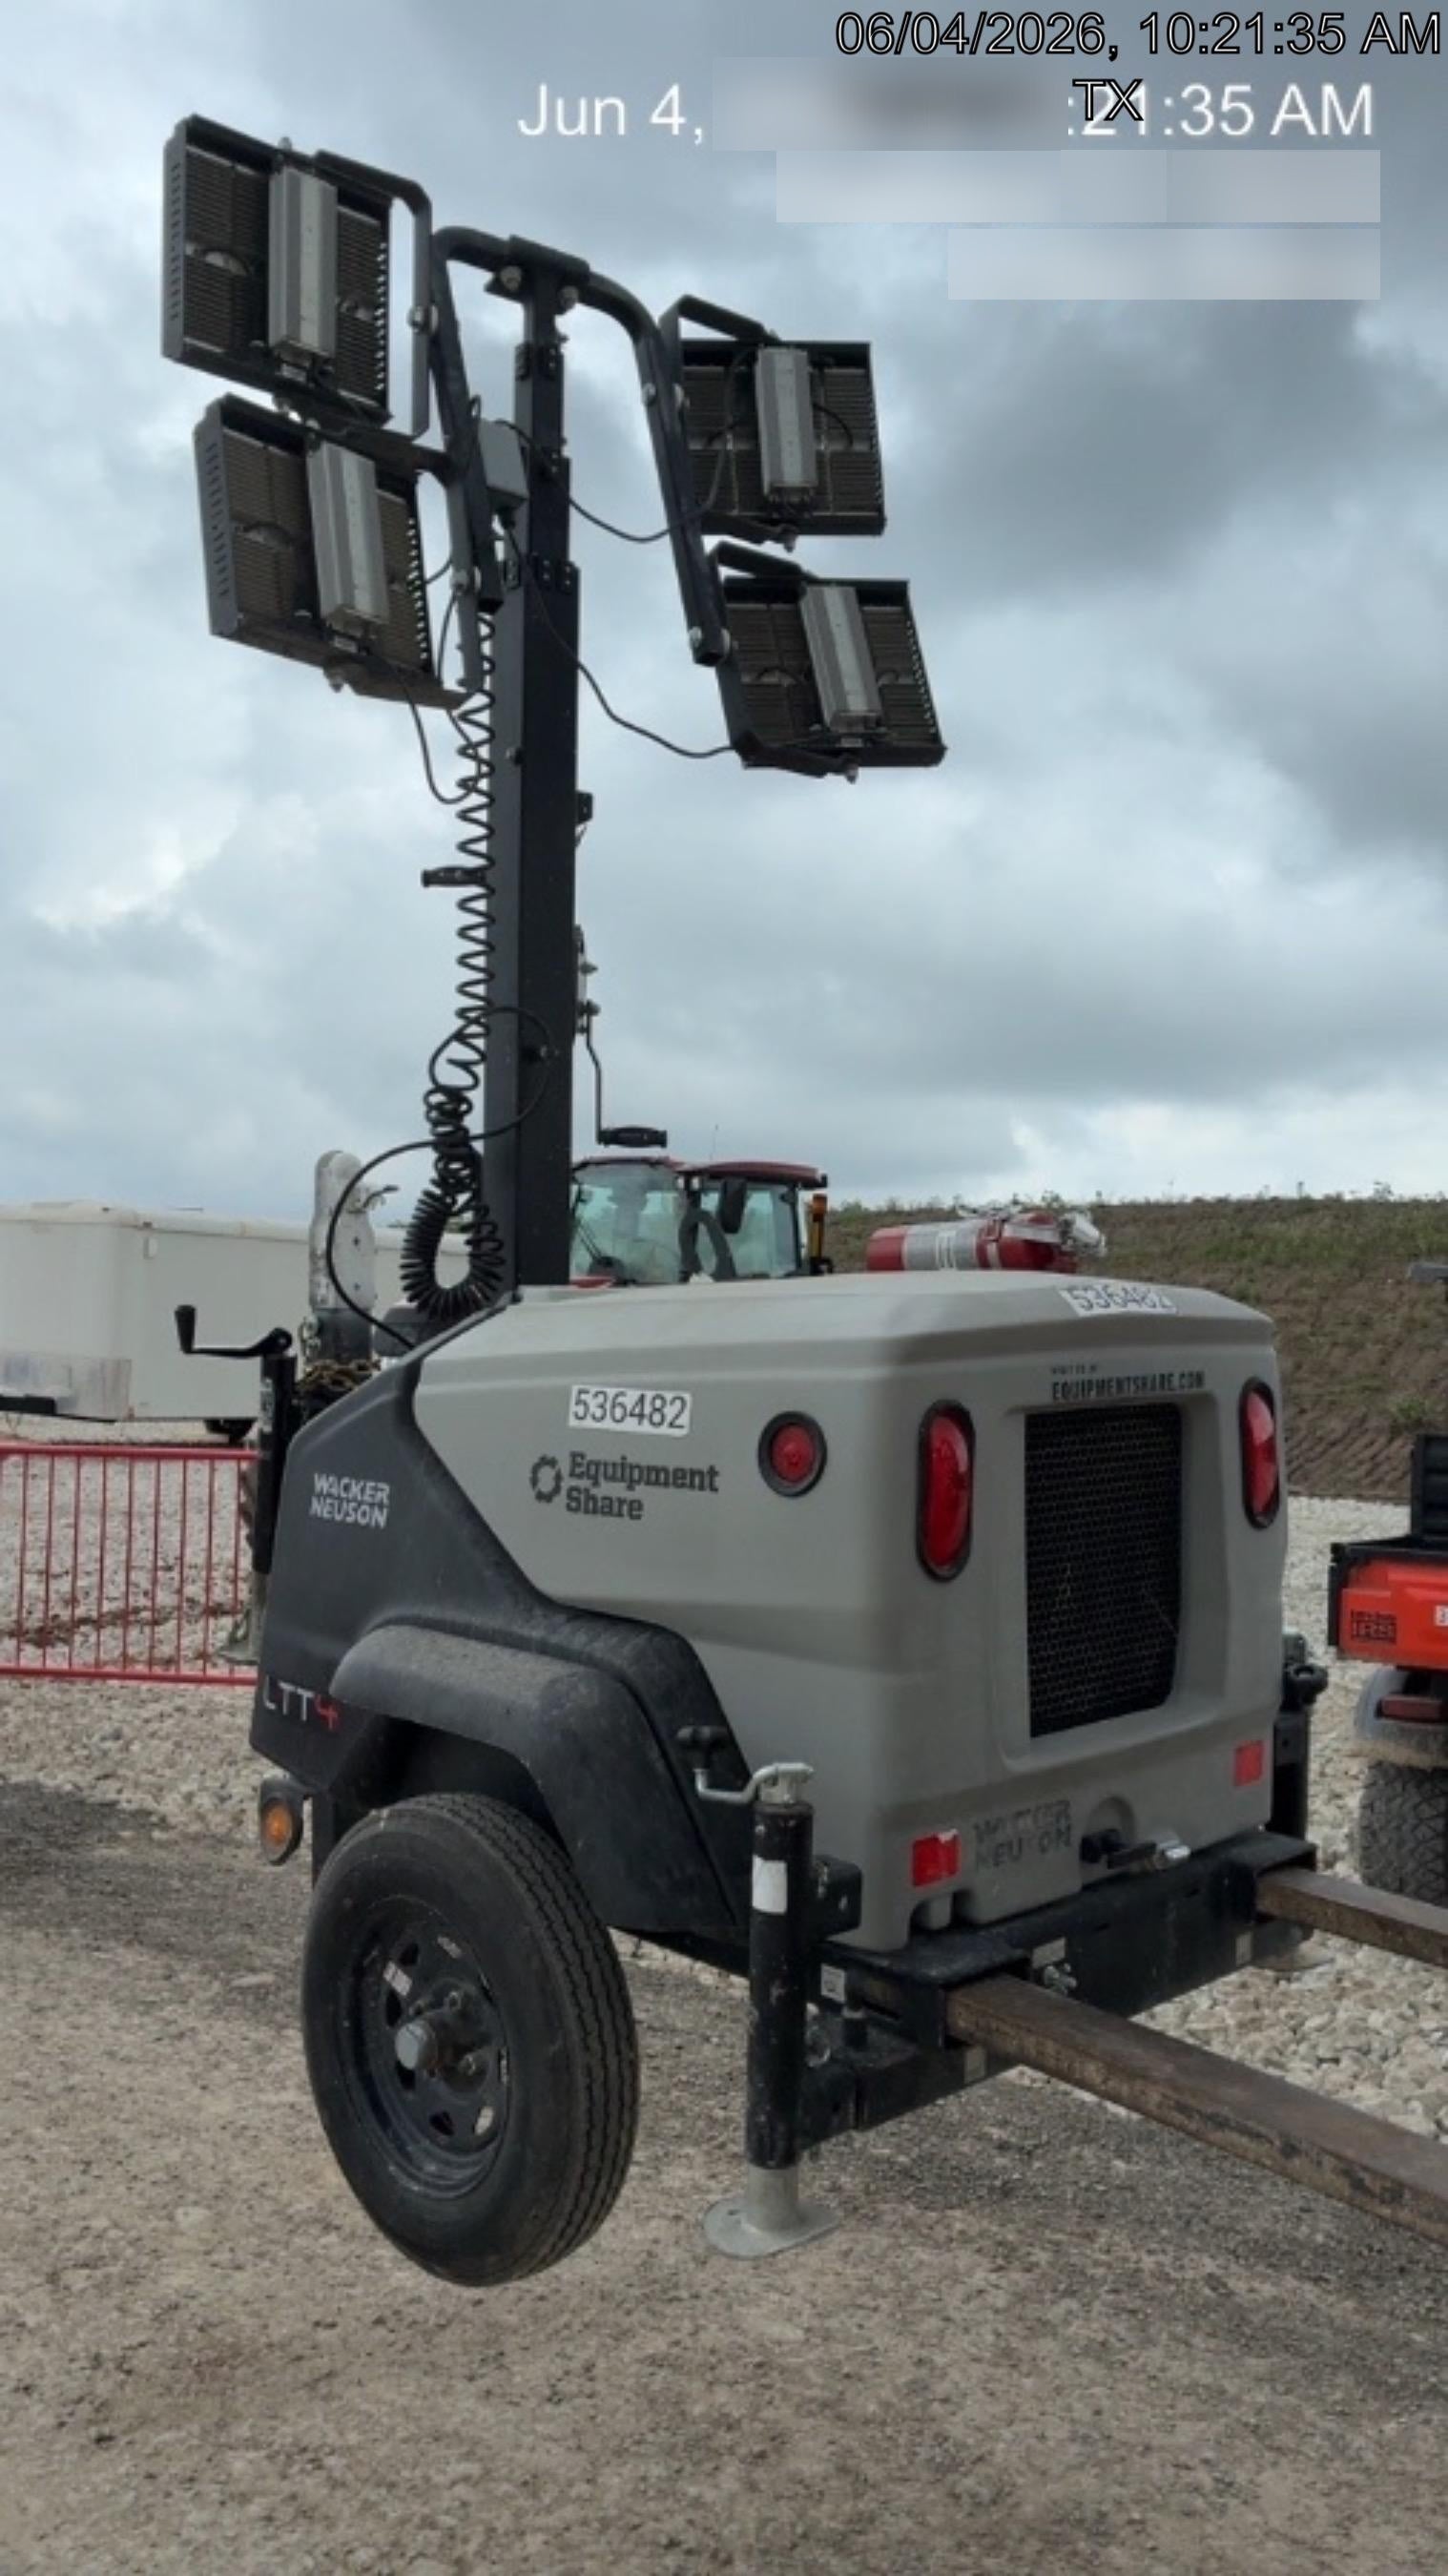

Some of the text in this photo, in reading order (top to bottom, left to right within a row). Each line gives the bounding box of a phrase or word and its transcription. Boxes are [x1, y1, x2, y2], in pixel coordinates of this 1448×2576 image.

[574, 1388, 687, 1429] 536482
[314, 1472, 390, 1506] WACKER
[569, 1450, 720, 1493] Equipment
[309, 1495, 388, 1529] NEUSON
[566, 1485, 645, 1521] Share
[262, 1674, 339, 1732] LTT4
[975, 1828, 1070, 1873] NEUON
